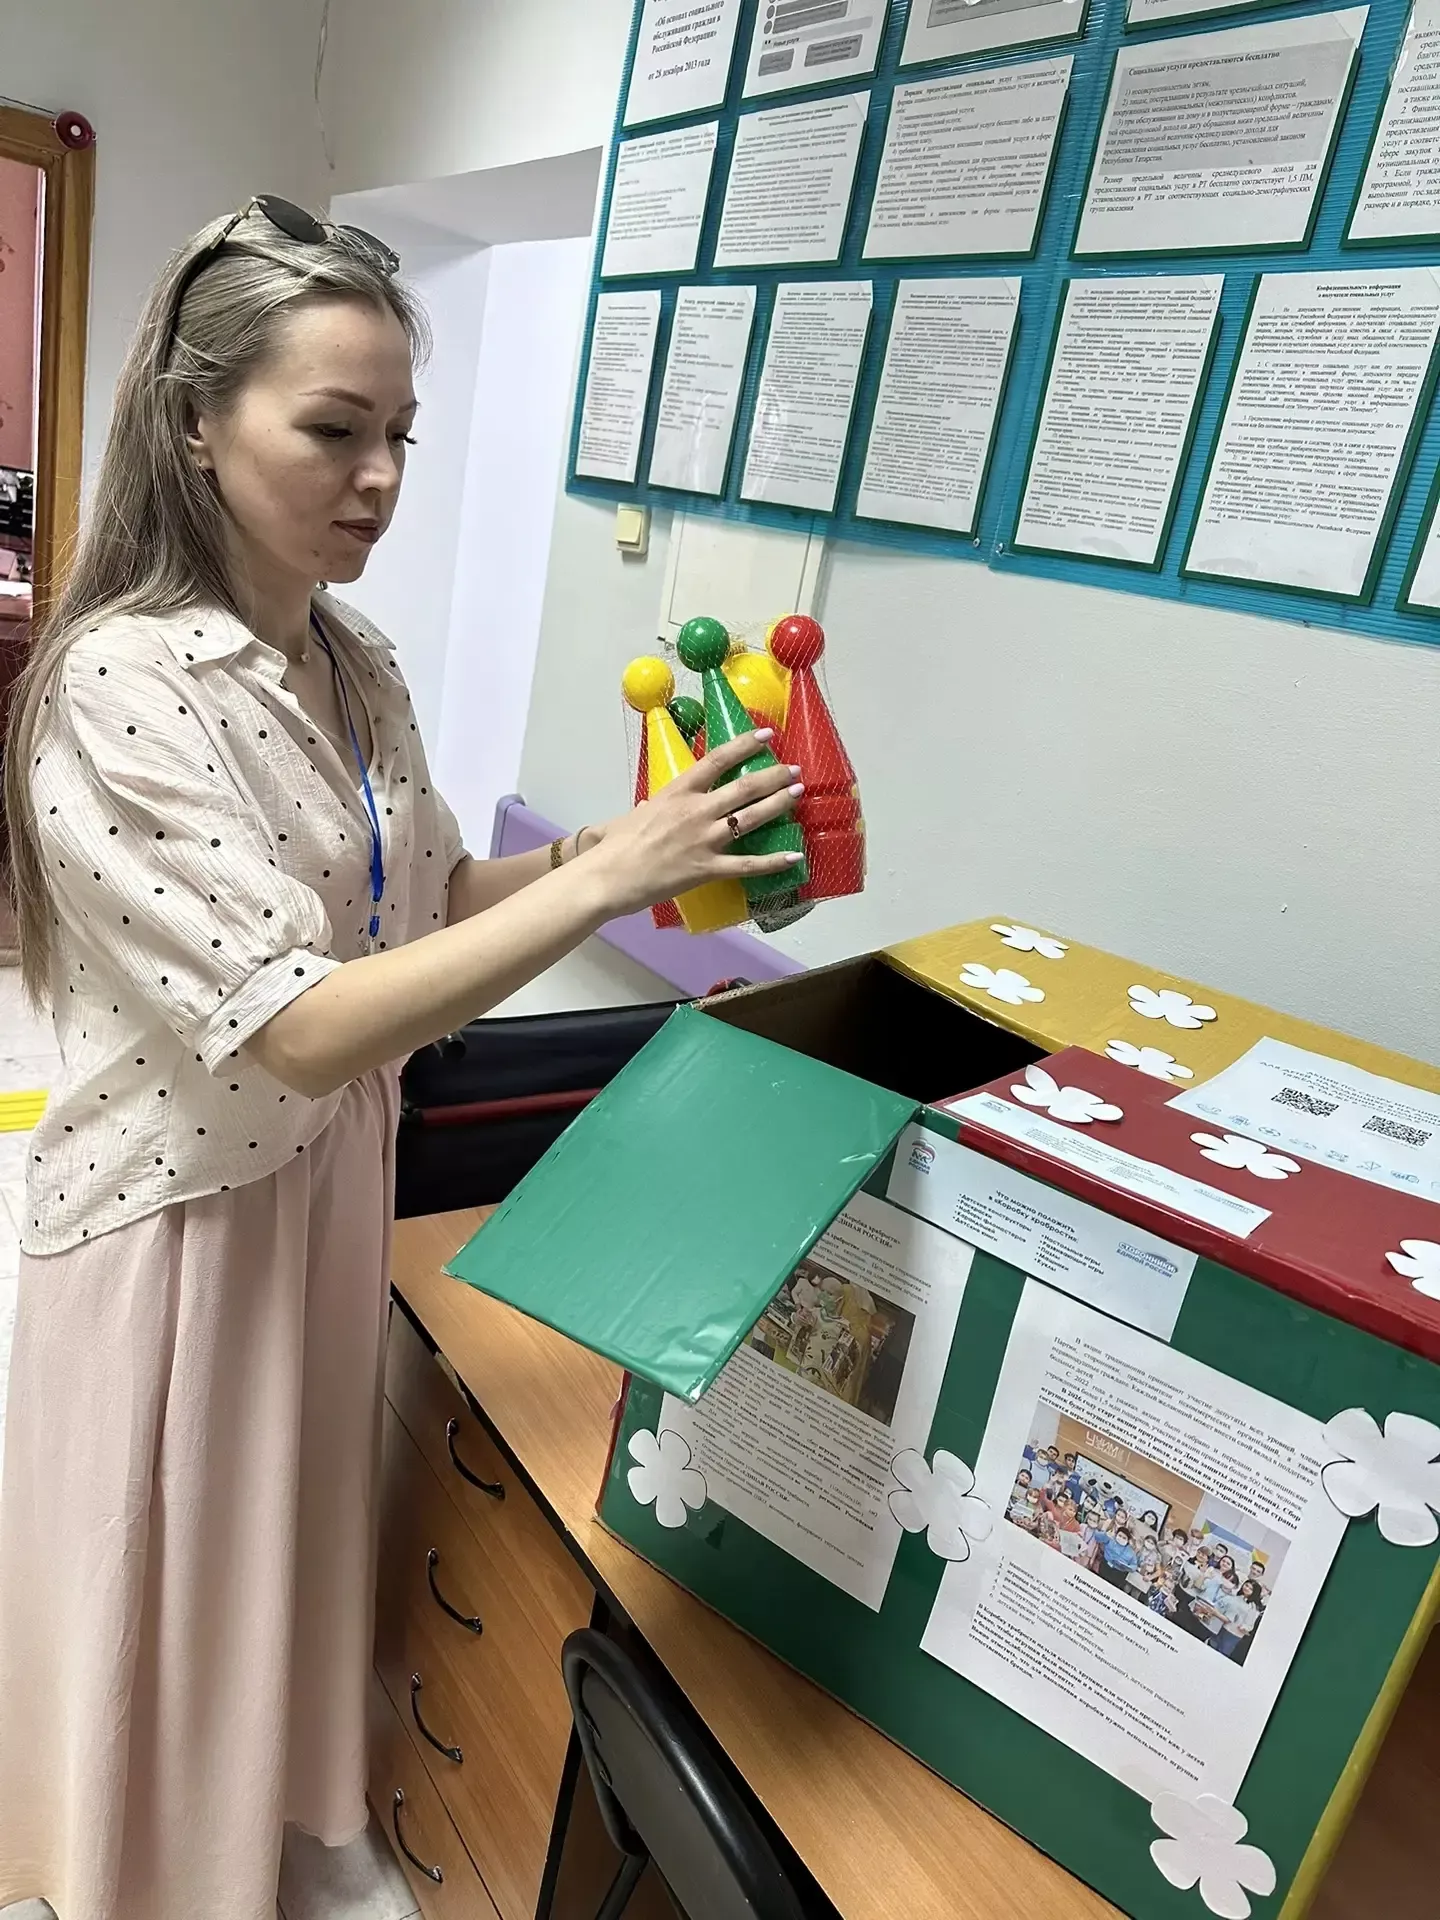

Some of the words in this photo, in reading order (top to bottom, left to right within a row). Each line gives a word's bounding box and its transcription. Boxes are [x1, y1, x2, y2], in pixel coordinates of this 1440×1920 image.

[666, 12, 687, 24] основах
[688, 1, 724, 16] социального
[653, 24, 691, 40] обслуживания
[692, 16, 716, 31] граждан
[652, 38, 682, 54] Российской
[683, 31, 717, 44] Федерации»
[663, 65, 683, 76] декабря
[684, 60, 697, 71] 2013
[698, 59, 710, 67] года
[1129, 66, 1165, 76] Социальные
[1166, 64, 1187, 72] услуги
[1188, 56, 1243, 69] предоставляются
[1410, 73, 1437, 82] доходы
[1380, 150, 1399, 159] сфере
[1404, 148, 1432, 156] закупок
[1382, 140, 1402, 148] услуг
[1377, 160, 1429, 169] муниципальных
[1288, 174, 1297, 182] 1,5
[1364, 201, 1390, 210] размере
[908, 1161, 930, 1175] РОССИЯ
[960, 1200, 992, 1218] Раскраски
[961, 1194, 987, 1209] Детские
[988, 1208, 1031, 1232] конструкторы
[994, 1199, 1029, 1219] «Коробку
[996, 1190, 1009, 1200] Что
[1010, 1199, 1036, 1214] можно
[1037, 1212, 1074, 1233] положить
[842, 1213, 867, 1228] «Коробка
[869, 1226, 900, 1244] храбрости»
[955, 1218, 980, 1232] Детские
[981, 1232, 997, 1241] книги
[959, 1206, 981, 1220] Наборы
[983, 1219, 1026, 1242] фломастеров
[1039, 1253, 1069, 1270] Машинки
[1042, 1241, 1086, 1266] Развивающие
[1088, 1265, 1104, 1274] игры
[1044, 1235, 1083, 1257] Настольные
[1084, 1256, 1100, 1266] игры
[1118, 1242, 1177, 1273] СТОРОННИКИ
[1037, 1259, 1056, 1271] Куклы
[1105, 1353, 1145, 1375] традиционно
[1187, 1394, 1212, 1409] участие
[1215, 1409, 1246, 1427] депутаты
[1249, 1426, 1263, 1436] всех
[1300, 1453, 1321, 1467] члены
[1127, 1374, 1172, 1399] представители
[1298, 1463, 1318, 1476] также
[1041, 1387, 1068, 1403] игрушек
[1069, 1401, 1084, 1412] будет
[1213, 1479, 1252, 1503] территории
[1254, 1502, 1269, 1513] всей
[1271, 1512, 1297, 1530] страны
[1083, 1400, 1096, 1409] году
[1098, 1408, 1115, 1418] старт
[1117, 1418, 1137, 1429] акции
[1138, 1428, 1173, 1449] приурочен
[1183, 1452, 1199, 1463] Дню
[1201, 1462, 1227, 1479] защиты
[1228, 1478, 1248, 1490] детей
[1283, 1508, 1300, 1521] Сбор
[1063, 1578, 1074, 1587] для
[1075, 1586, 1110, 1610] наполнения
[1112, 1609, 1141, 1630] «Коробки
[1143, 1628, 1178, 1653] храбрости»
[1074, 1574, 1110, 1600] Примерный
[1111, 1599, 1138, 1618] перечень
[1140, 1617, 1172, 1640] предметов
